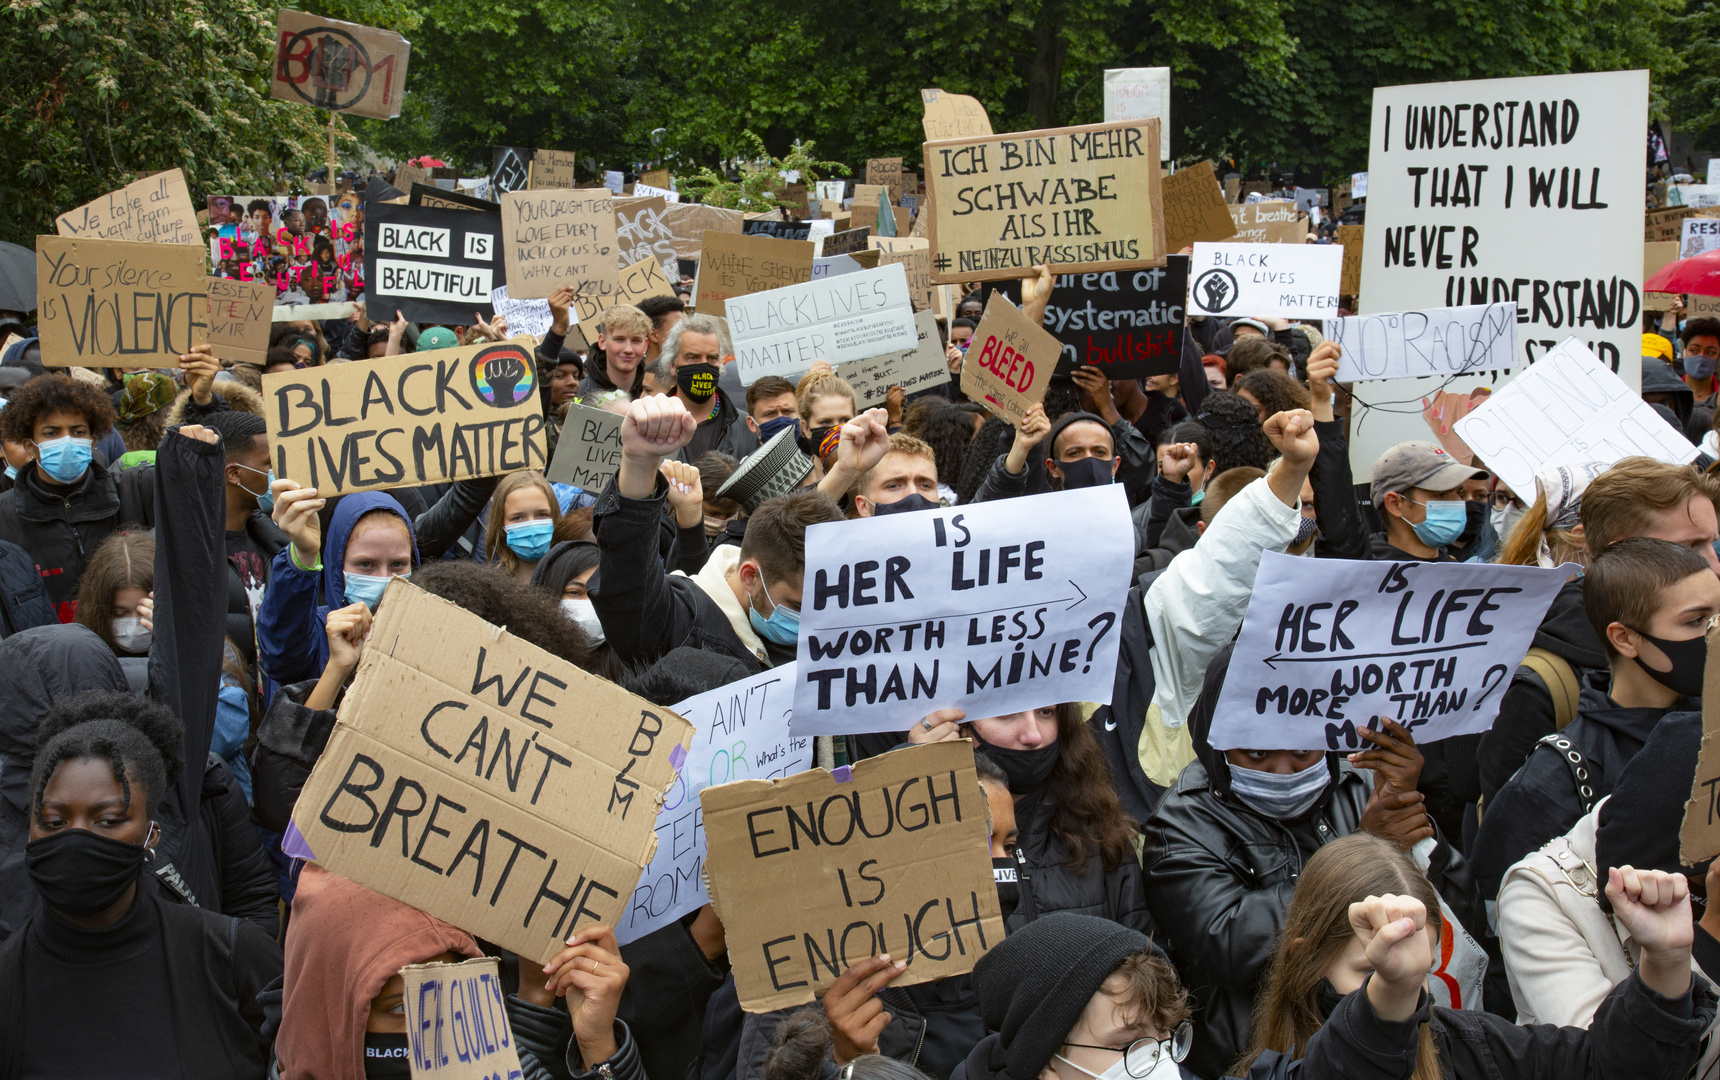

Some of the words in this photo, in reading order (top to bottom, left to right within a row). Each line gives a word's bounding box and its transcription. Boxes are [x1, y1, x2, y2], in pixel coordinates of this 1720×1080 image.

[1384, 105, 1391, 152] I
[1405, 98, 1580, 151] UNDERSTAND
[939, 144, 988, 177] ICH
[1000, 137, 1057, 171] BIN
[1070, 128, 1144, 163] MEHR
[61, 207, 100, 234] We
[109, 190, 142, 220] take
[149, 177, 170, 203] all
[952, 174, 1118, 217] SCHWABE
[1407, 163, 1488, 209] THAT
[1505, 164, 1514, 209] I
[1529, 166, 1608, 210] WILL
[98, 211, 133, 239] want
[137, 206, 170, 230] from
[513, 198, 551, 224] YOUR
[1000, 213, 1046, 241] ALS
[1053, 208, 1102, 237] IHR
[219, 227, 312, 260] BLACK
[331, 219, 354, 242] IS
[384, 227, 445, 253] BLACK
[470, 237, 488, 254] IS
[515, 225, 551, 243] LOVE
[555, 223, 599, 242] EVERY
[1384, 225, 1479, 270] NEVER
[42, 250, 100, 288] Your
[102, 259, 177, 289] silence
[517, 247, 545, 262] INCH
[550, 245, 570, 259] OF
[572, 244, 590, 256] US
[522, 265, 551, 280] WHY
[554, 264, 589, 278] CANT
[811, 264, 832, 276] OT
[1213, 251, 1269, 267] BLACK
[383, 267, 488, 297] BEAUTIFUL
[575, 279, 612, 295] YOU
[1132, 267, 1166, 292] of
[1253, 272, 1296, 284] LIVES
[42, 296, 57, 320] is
[730, 292, 812, 334] BLACK
[812, 278, 887, 321] LIVES
[1043, 299, 1183, 333] systematic
[1279, 294, 1338, 309] MATTER!
[740, 333, 825, 371] MATTER
[1087, 330, 1179, 365] bullshit
[1379, 313, 1399, 329] TO
[1402, 311, 1514, 375] RACISM
[919, 368, 945, 383] MATTER
[979, 335, 1035, 393] BLEED
[274, 358, 474, 438] BLACK
[691, 380, 713, 389] LIVES
[277, 428, 406, 493] LIVES
[412, 413, 546, 482] MATTER
[933, 513, 972, 548] IS
[813, 555, 915, 611] HER
[952, 540, 1046, 591] LIFE
[1377, 562, 1420, 593] IS
[808, 620, 946, 662] WORTH
[967, 607, 1047, 646] LESS
[1275, 599, 1360, 653] HER
[1390, 586, 1523, 646] LIFE
[470, 646, 568, 730] WE
[806, 659, 940, 711] THAN
[1331, 656, 1458, 697] WORTH
[709, 678, 781, 745] AIN'T
[1255, 684, 1350, 720] MORE
[1389, 688, 1468, 720] THAN
[420, 700, 573, 806] CAN'T
[607, 709, 663, 821] BLM
[755, 743, 786, 769] What's
[789, 737, 807, 753] the
[746, 770, 962, 859] ENOUGH
[837, 859, 885, 908] IS
[762, 891, 988, 992] ENOUGH
